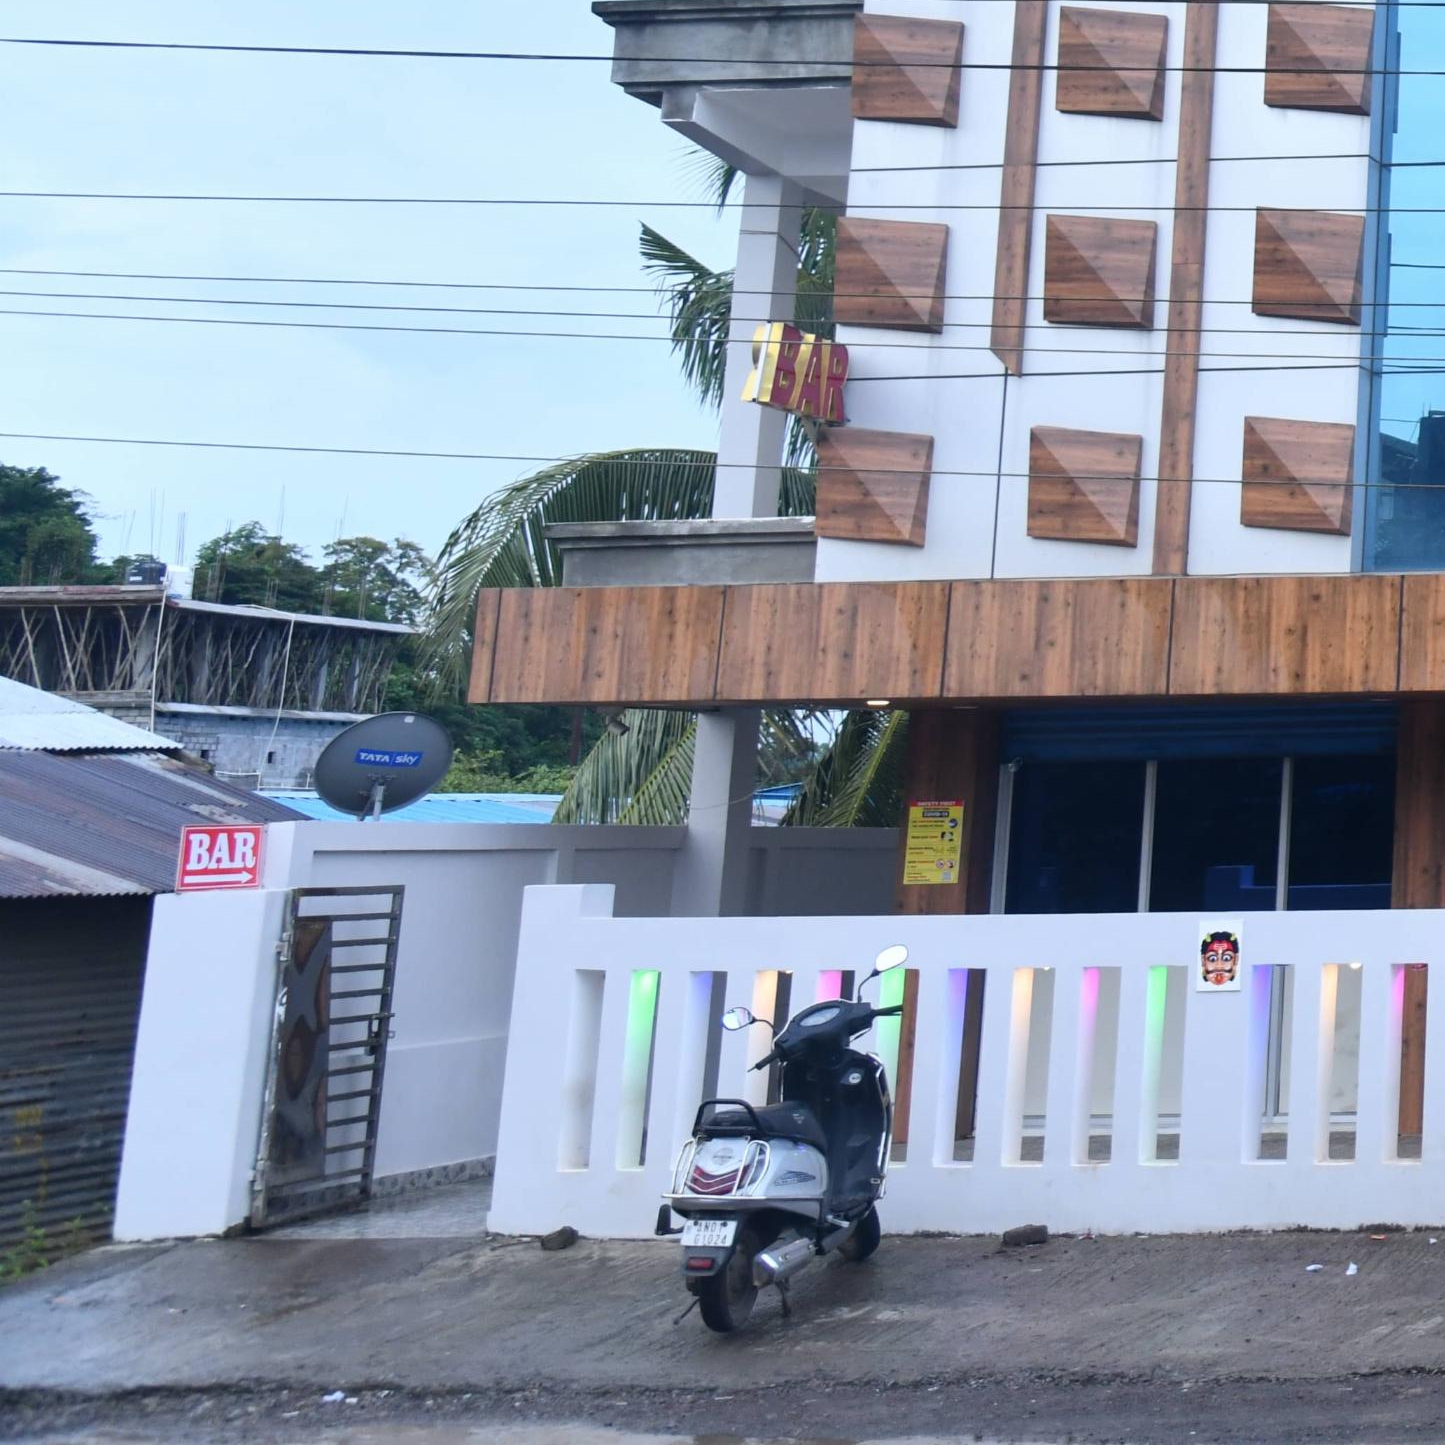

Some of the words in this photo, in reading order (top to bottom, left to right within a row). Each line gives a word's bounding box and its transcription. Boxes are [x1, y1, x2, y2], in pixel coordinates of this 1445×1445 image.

[764, 322, 849, 423] BAR
[360, 752, 390, 762] TATA
[186, 831, 256, 871] BAR
